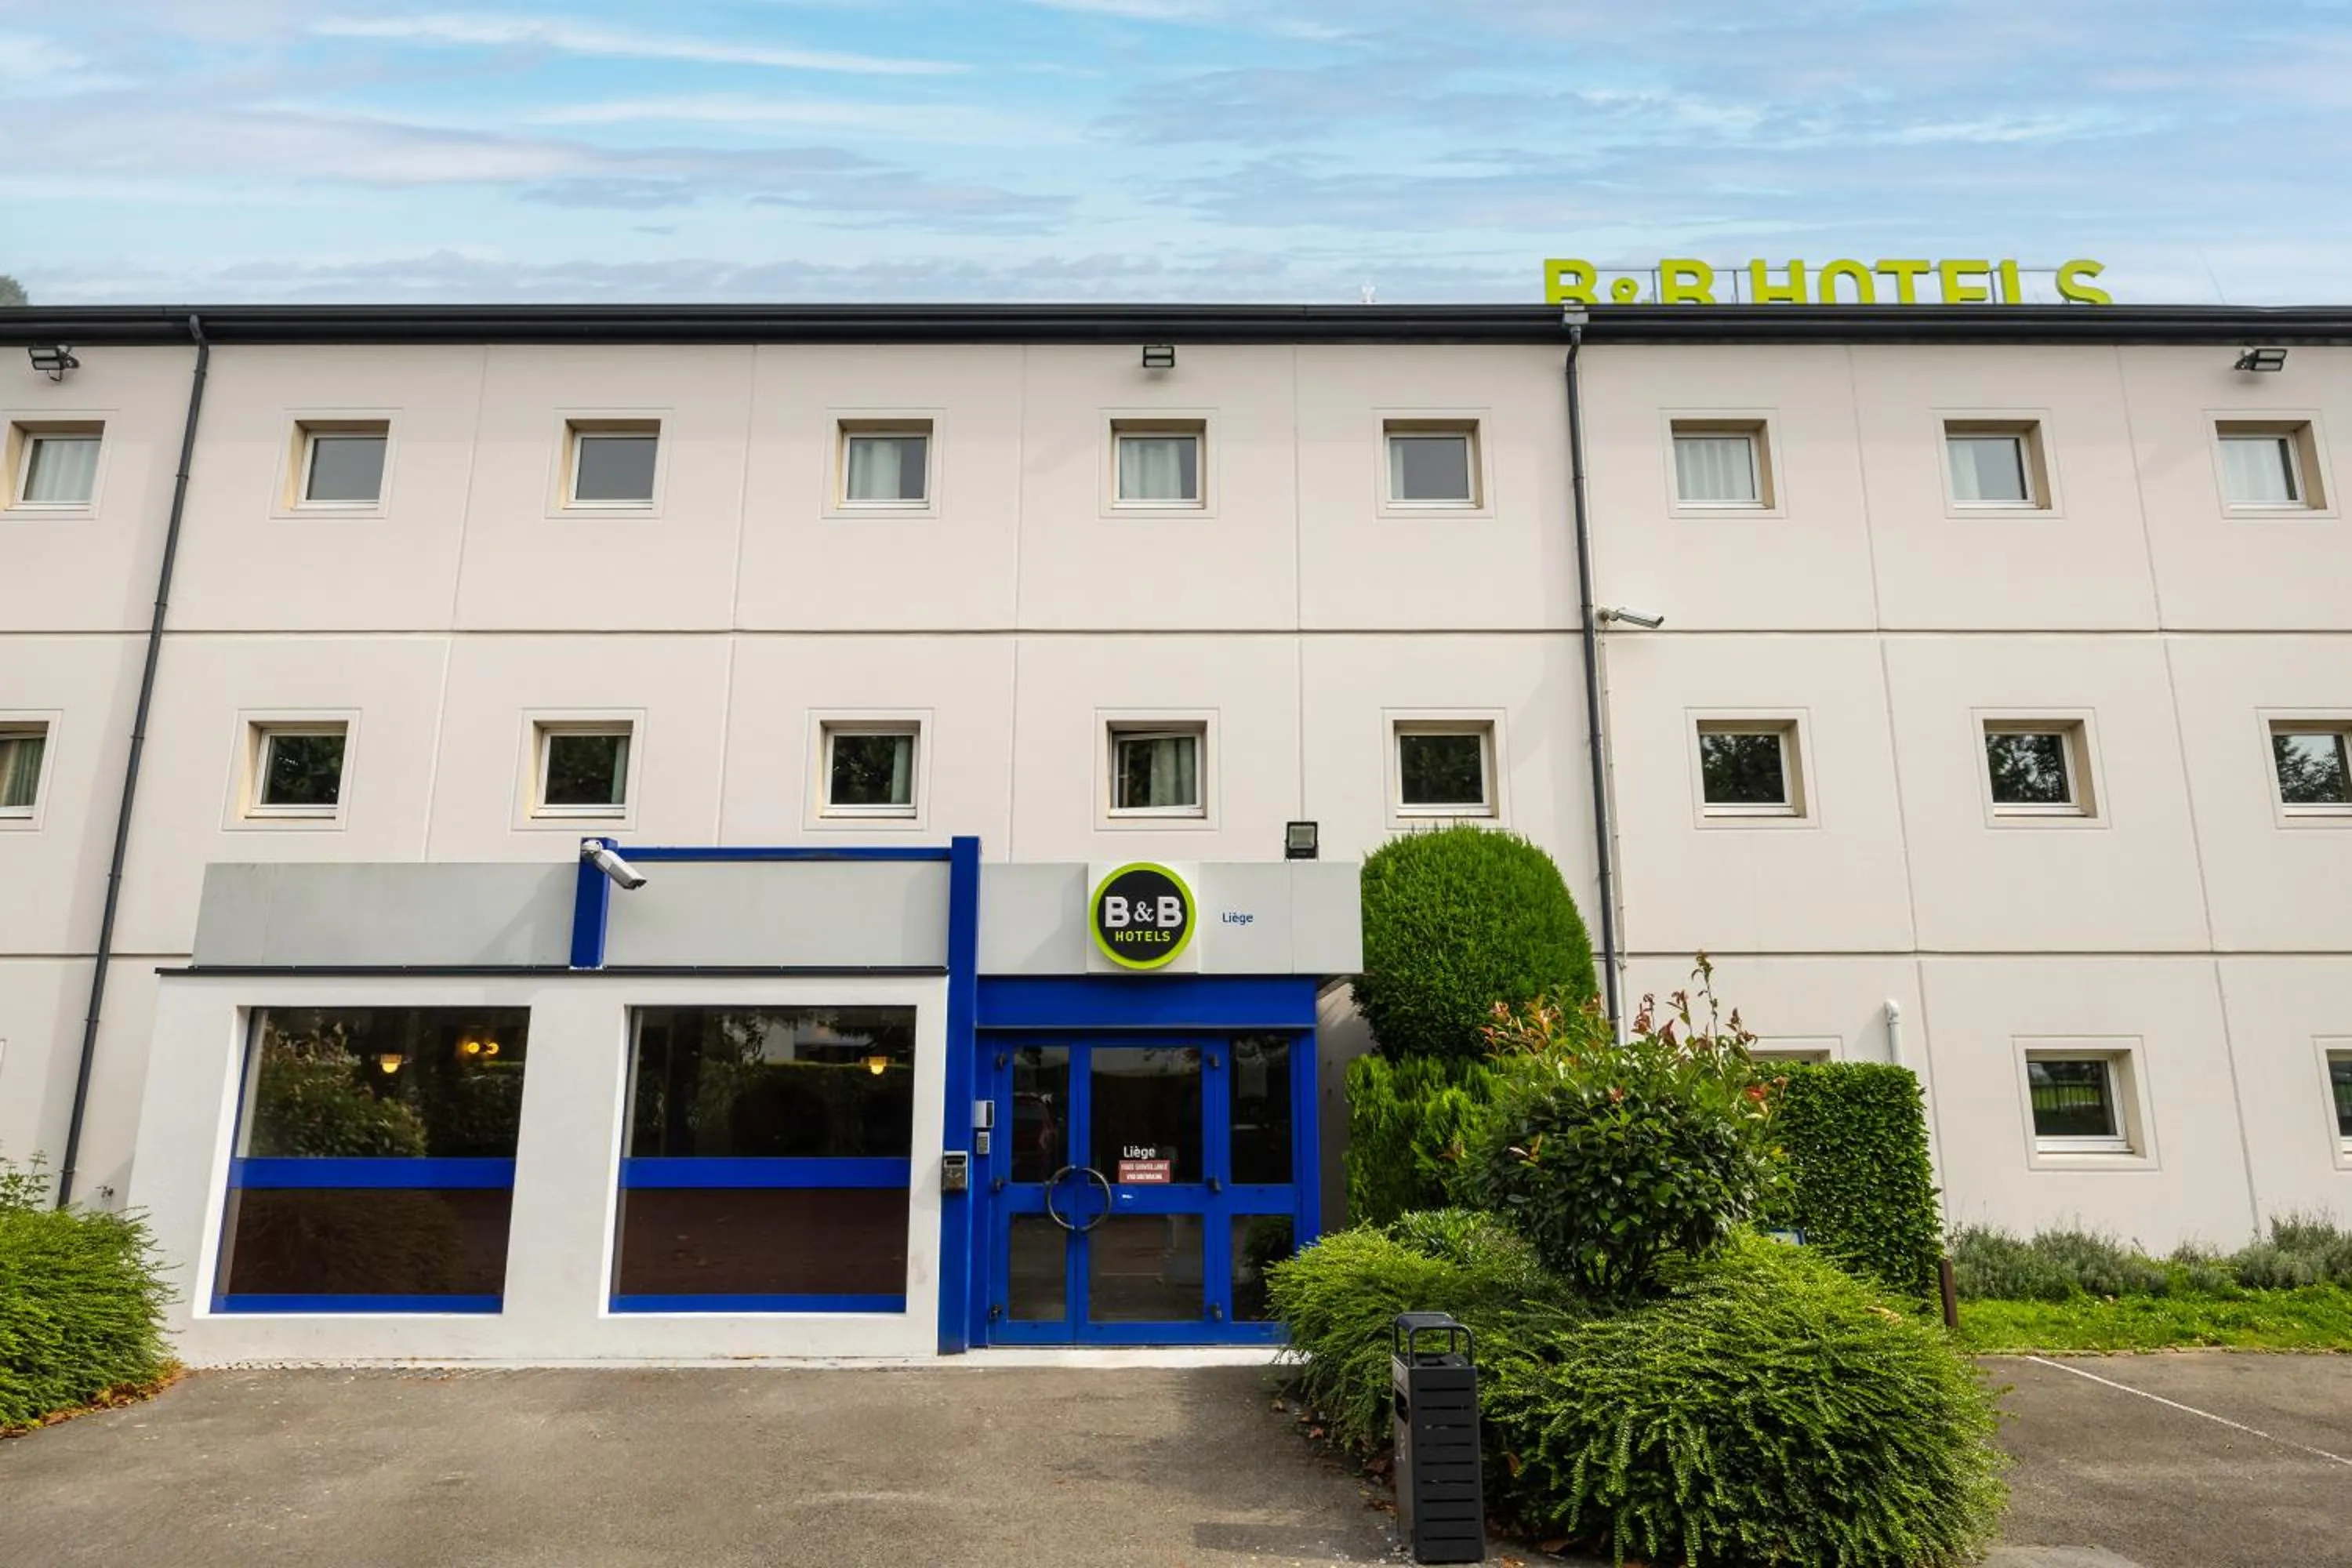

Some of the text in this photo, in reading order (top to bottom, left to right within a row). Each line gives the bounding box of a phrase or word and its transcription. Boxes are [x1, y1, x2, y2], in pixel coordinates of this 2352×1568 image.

[1105, 896, 1183, 927] B&B
[1222, 912, 1254, 926] Liège
[1115, 931, 1171, 942] HOTELS
[1123, 1145, 1156, 1160] Liège
